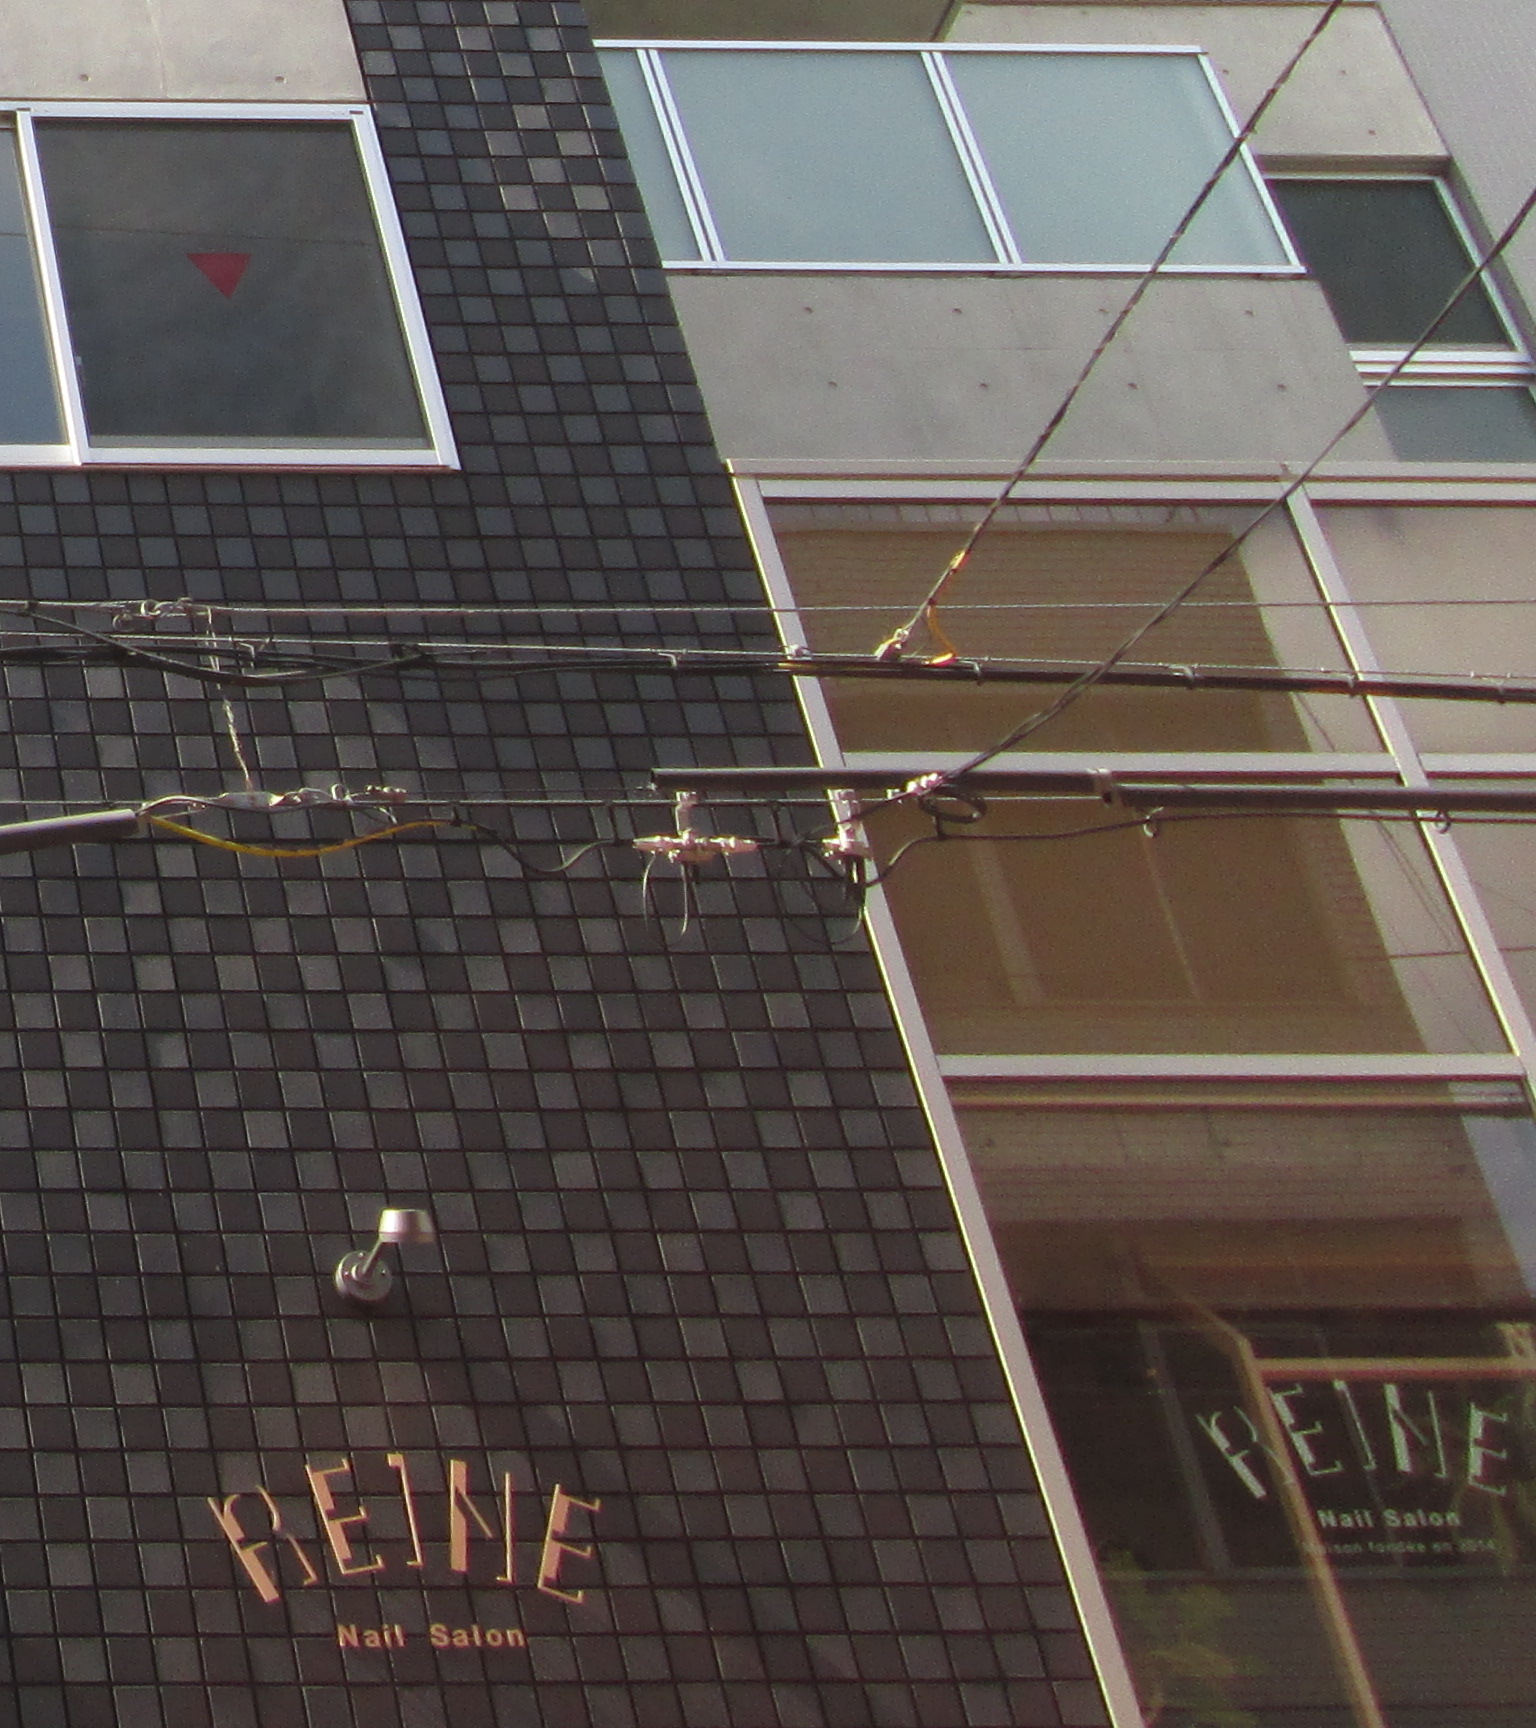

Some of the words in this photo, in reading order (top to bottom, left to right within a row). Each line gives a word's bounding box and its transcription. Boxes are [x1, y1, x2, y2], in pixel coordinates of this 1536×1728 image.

[1196, 1379, 1508, 1500] REINE
[207, 1452, 602, 1604] REINE
[1318, 1509, 1374, 1529] Nail
[1383, 1507, 1461, 1528] Salon
[337, 1623, 406, 1648] Nail
[430, 1624, 526, 1648] Salon
